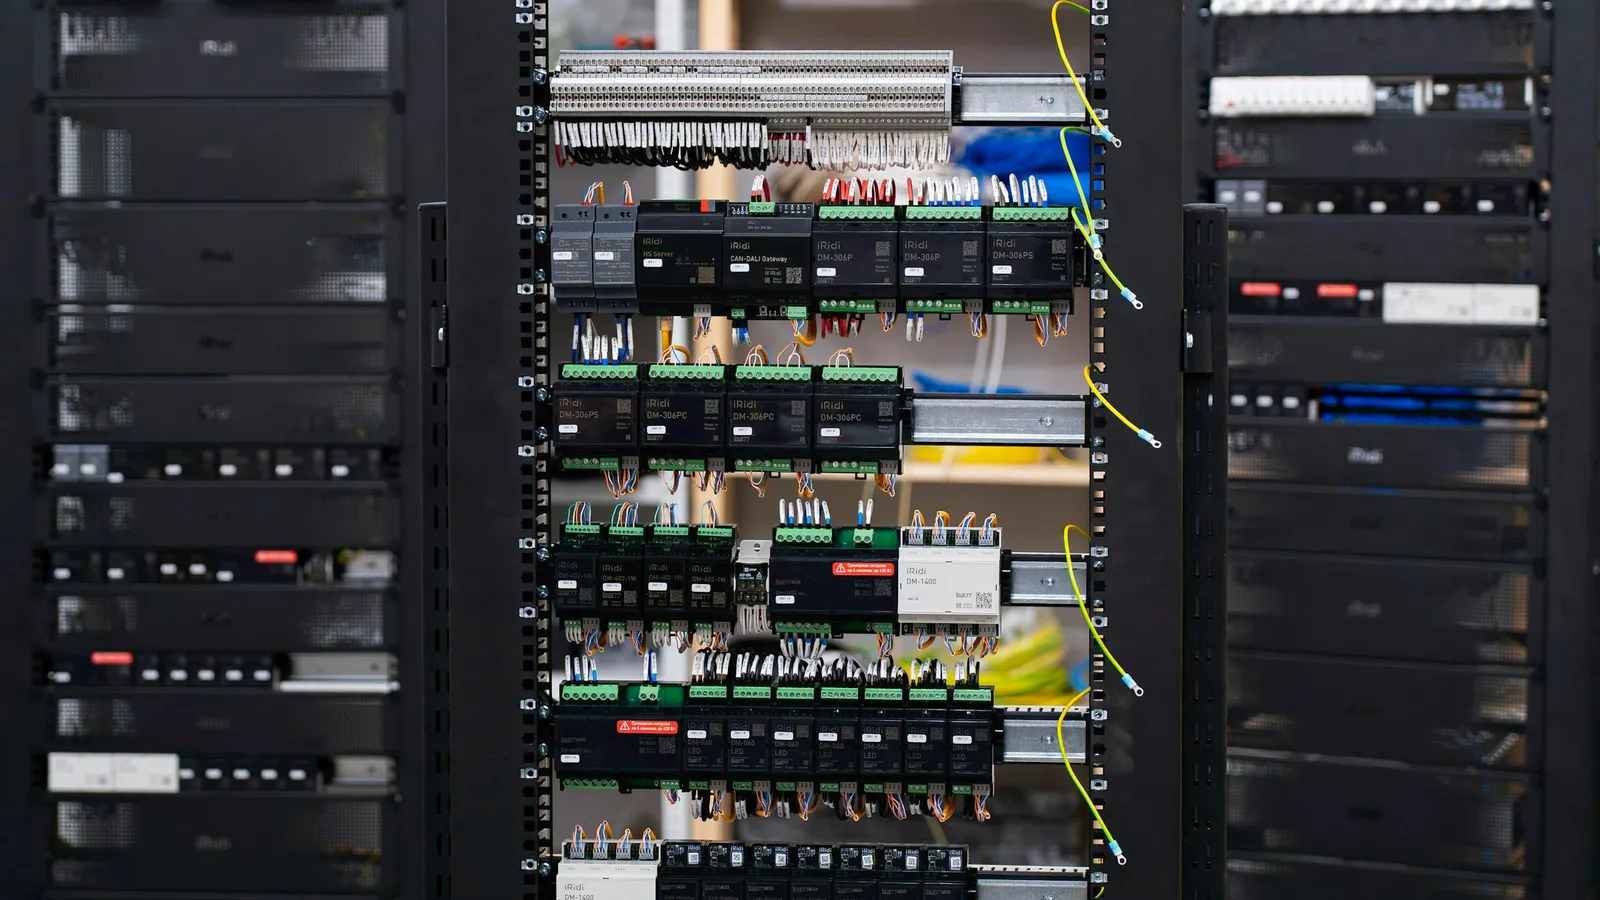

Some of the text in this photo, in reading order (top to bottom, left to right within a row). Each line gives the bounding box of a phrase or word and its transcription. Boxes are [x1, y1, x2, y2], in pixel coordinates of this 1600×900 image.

[817, 241, 841, 250] iRidi
[904, 240, 928, 249] iRidi
[992, 239, 1016, 247] iRidi
[817, 253, 853, 262] DM-306P
[904, 253, 940, 261] DM-306P
[559, 398, 582, 407] iRidi
[646, 399, 670, 407] iRidi
[733, 400, 757, 409] iRidi
[821, 401, 844, 410] iRidi
[646, 411, 687, 419] DM-306PC
[733, 412, 774, 420] DM-306PC
[821, 413, 862, 422] DM-306PC
[602, 564, 622, 572] iRidi
[648, 563, 668, 571] iRidi
[692, 565, 712, 573] iRidi
[906, 567, 927, 575] iRidi
[564, 883, 584, 891] iRidi
